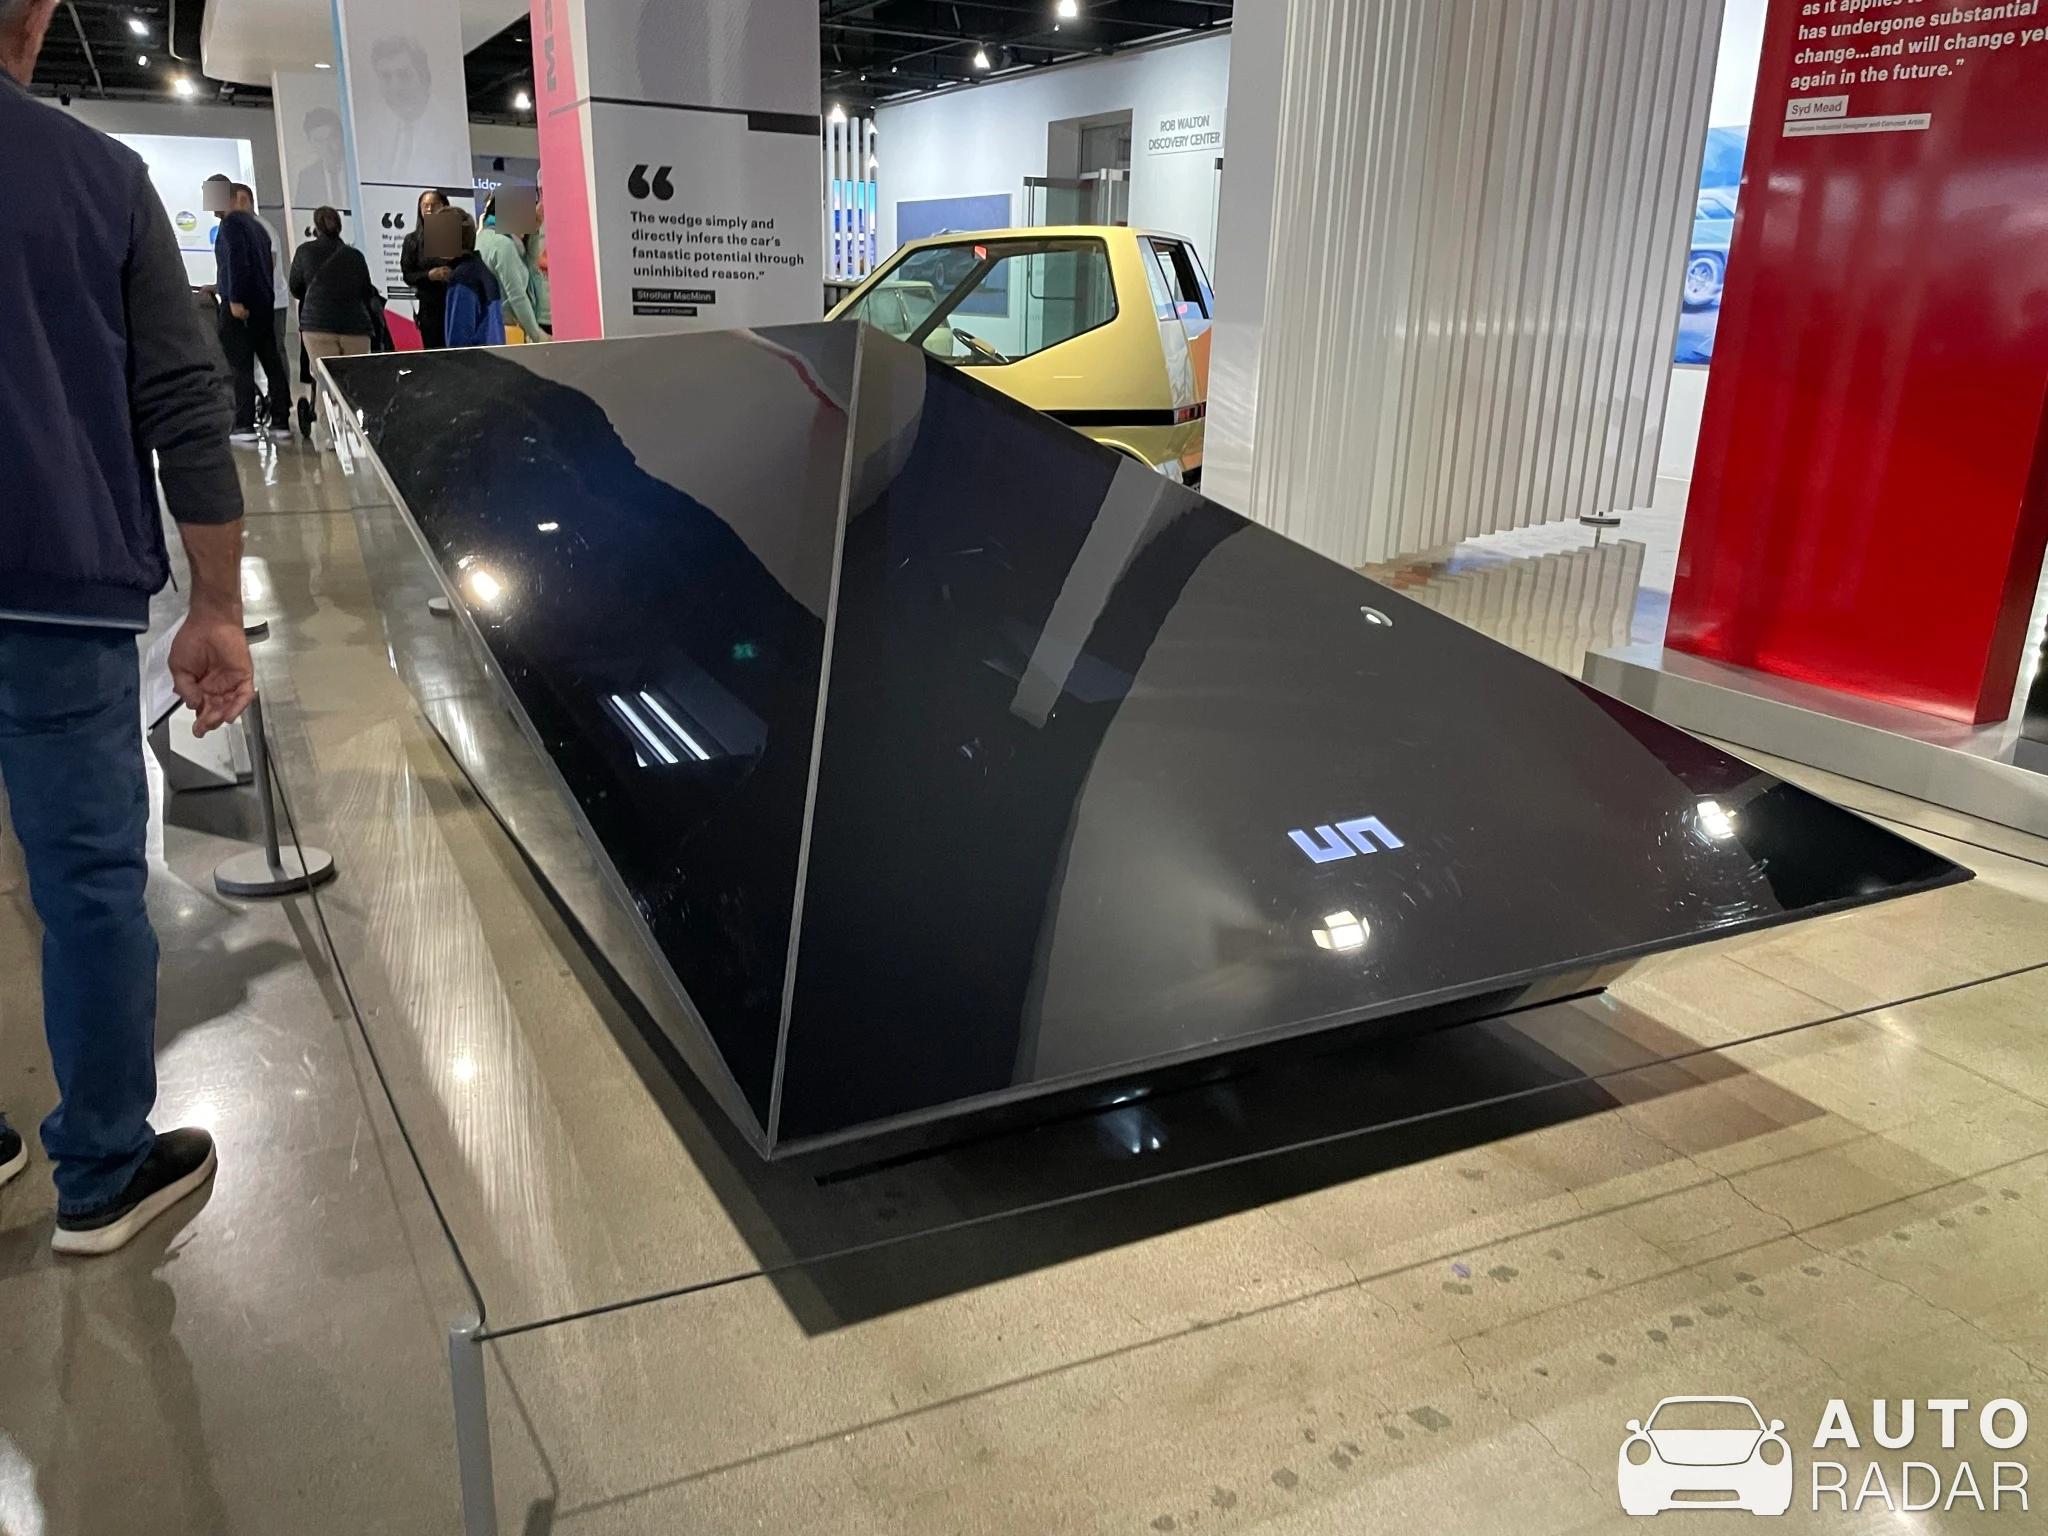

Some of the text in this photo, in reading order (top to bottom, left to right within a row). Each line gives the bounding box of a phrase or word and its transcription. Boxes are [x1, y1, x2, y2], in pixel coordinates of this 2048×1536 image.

[1802, 3, 1820, 16] as
[1798, 0, 2039, 40] has undergone substantial
[1908, 35, 1941, 54] will
[1944, 31, 2015, 51] change
[1790, 71, 1836, 91] again
[1839, 69, 1856, 85] in
[1860, 66, 1889, 83] the
[1791, 101, 1842, 116] Syd Mead
[1160, 115, 1210, 132] ROB WALTON
[1842, 122, 1868, 131] Designer
[1907, 118, 1925, 126] Artist
[1148, 132, 1221, 151] DISCOVERY CENTER
[630, 211, 774, 230] The wedge simply and
[631, 229, 683, 245] directly
[686, 231, 724, 245] infers
[727, 234, 748, 246] the
[633, 246, 804, 267] fantastic potential through
[633, 265, 709, 279] uninhibited
[637, 290, 711, 301] Strother MacMinn
